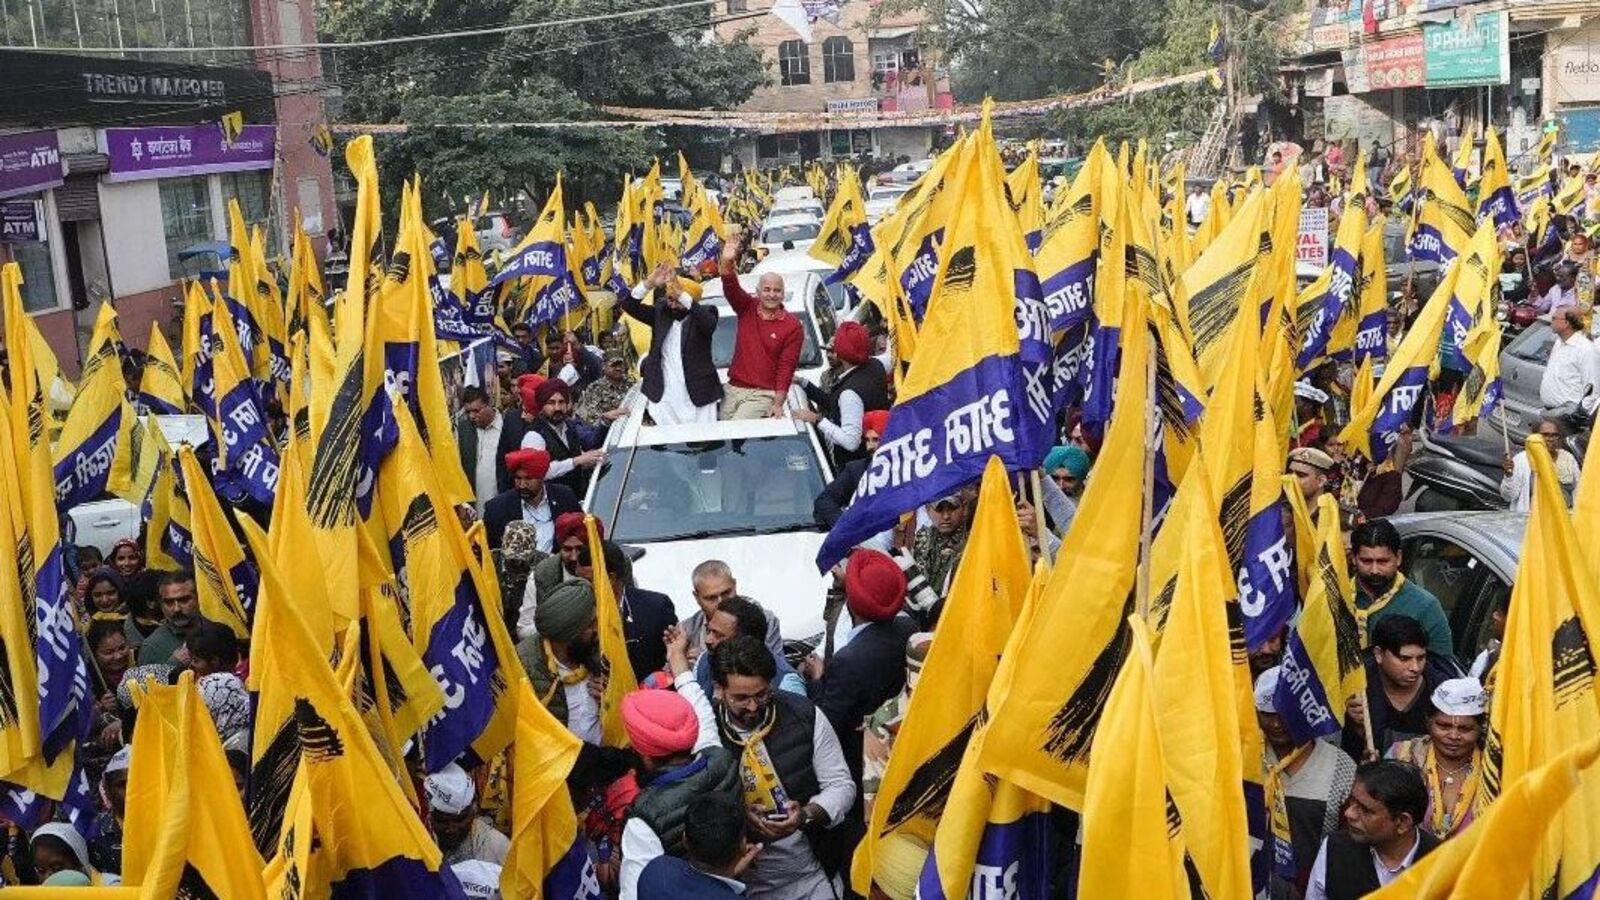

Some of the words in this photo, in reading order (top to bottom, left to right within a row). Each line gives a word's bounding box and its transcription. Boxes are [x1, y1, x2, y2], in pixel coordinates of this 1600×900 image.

[83, 73, 146, 93] TRENDY
[31, 149, 59, 167] ATM
[3, 221, 35, 234] ATM
